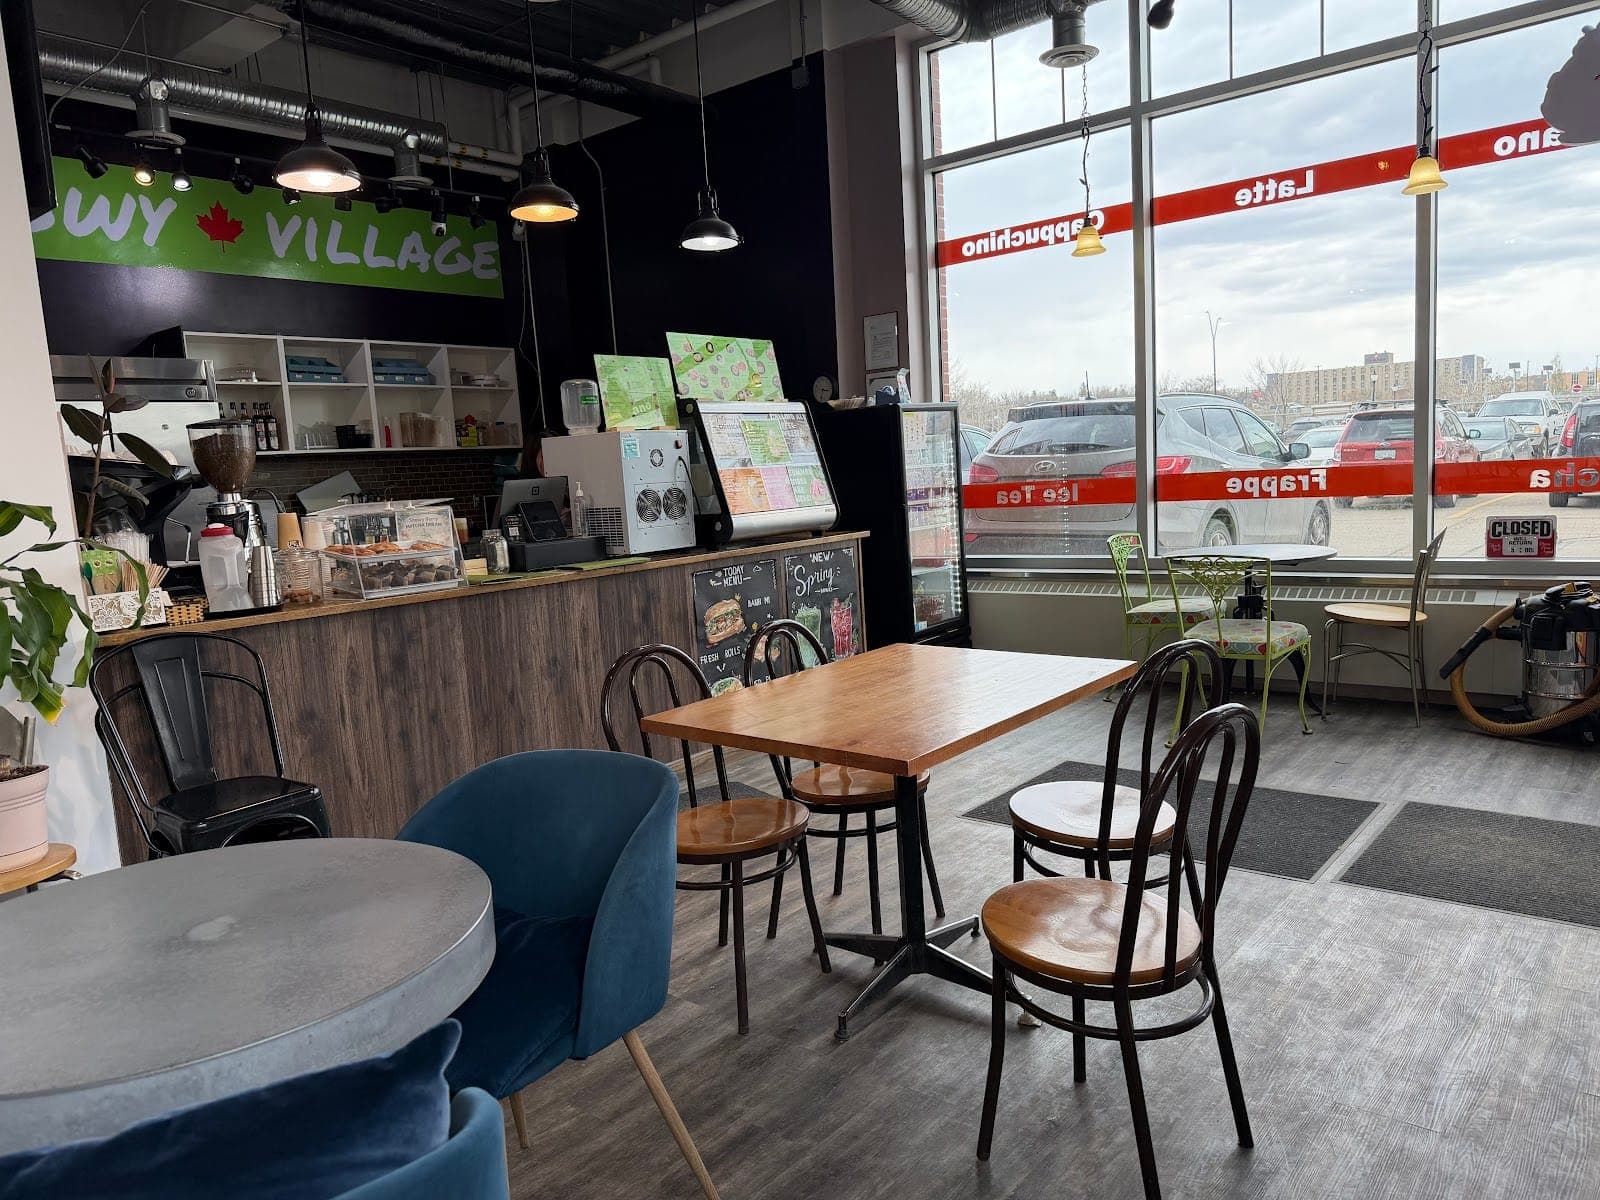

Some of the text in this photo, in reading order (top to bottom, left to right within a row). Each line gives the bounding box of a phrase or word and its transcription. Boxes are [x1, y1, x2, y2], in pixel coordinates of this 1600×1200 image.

[31, 186, 500, 280] WY VILLAGE
[1491, 520, 1551, 538] CLOSED
[811, 551, 831, 563] NEW
[723, 564, 744, 577] TODAY
[723, 575, 743, 587] MENU
[794, 564, 834, 596] Spring
[700, 646, 741, 665] FRESH ROLLS
